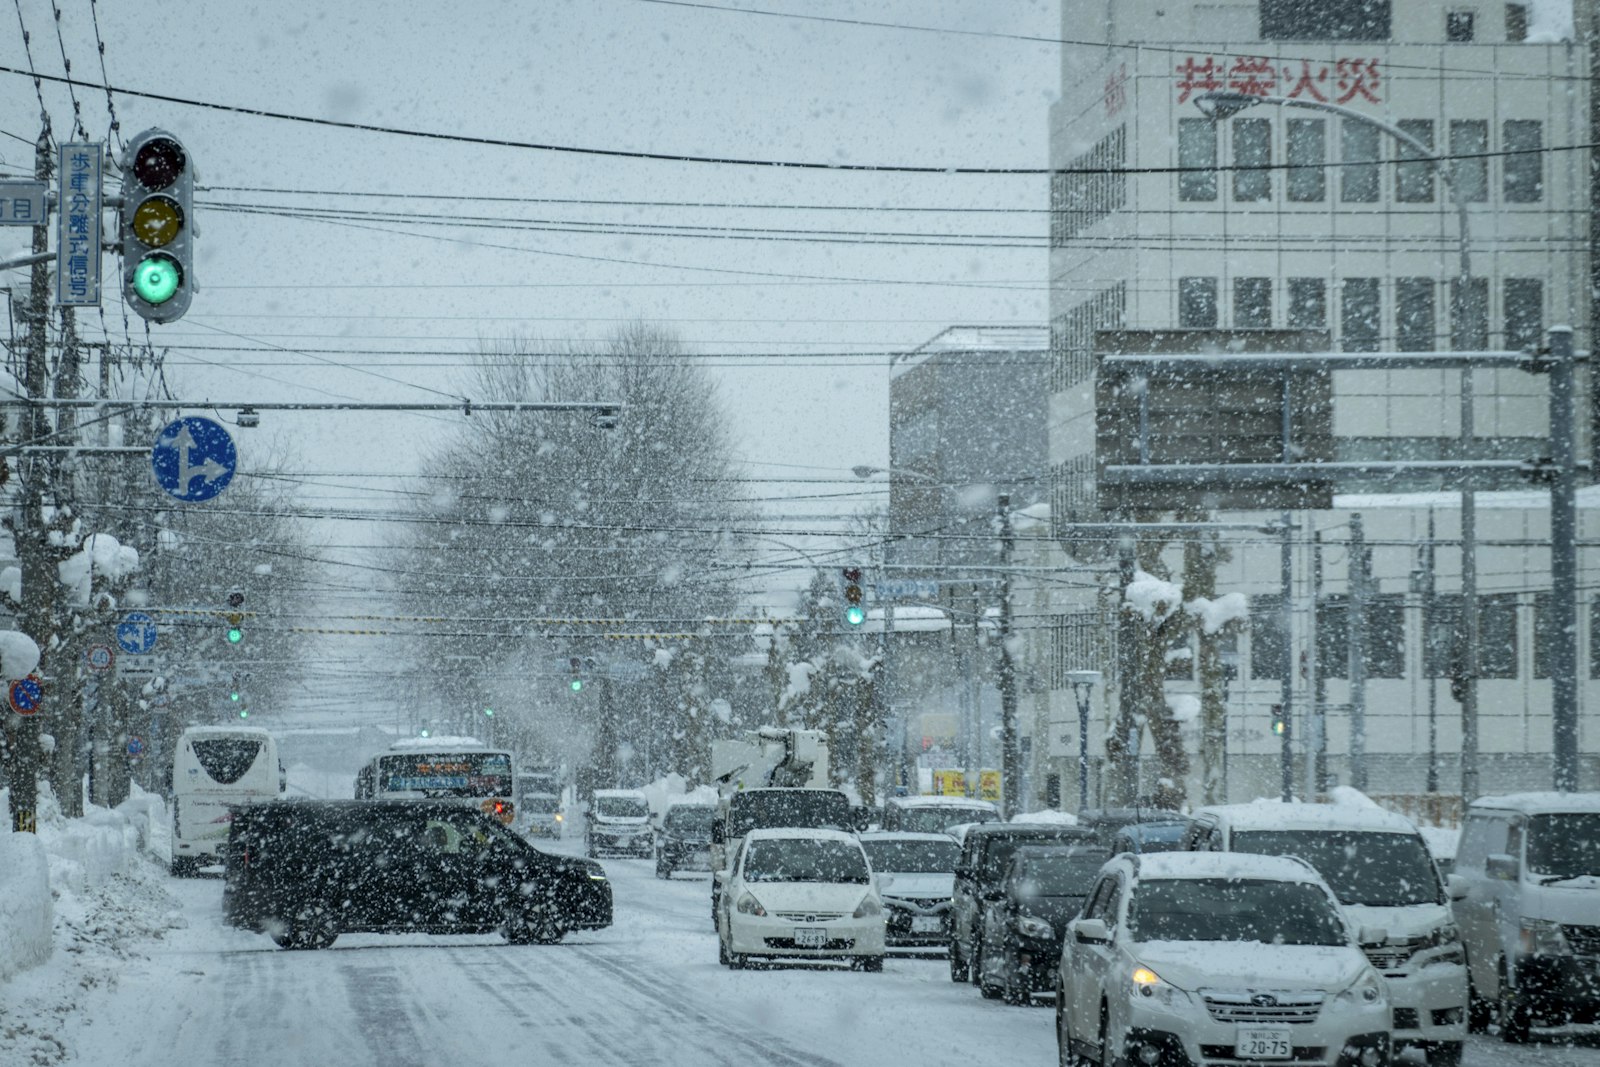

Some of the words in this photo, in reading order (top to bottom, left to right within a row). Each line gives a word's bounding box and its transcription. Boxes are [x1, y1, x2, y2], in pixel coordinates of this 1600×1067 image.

[1176, 57, 1382, 104] 共栄火災
[68, 152, 90, 296] 歩車分離式信号
[801, 935, 825, 943] 26-83
[1249, 1041, 1288, 1054] 20-75
